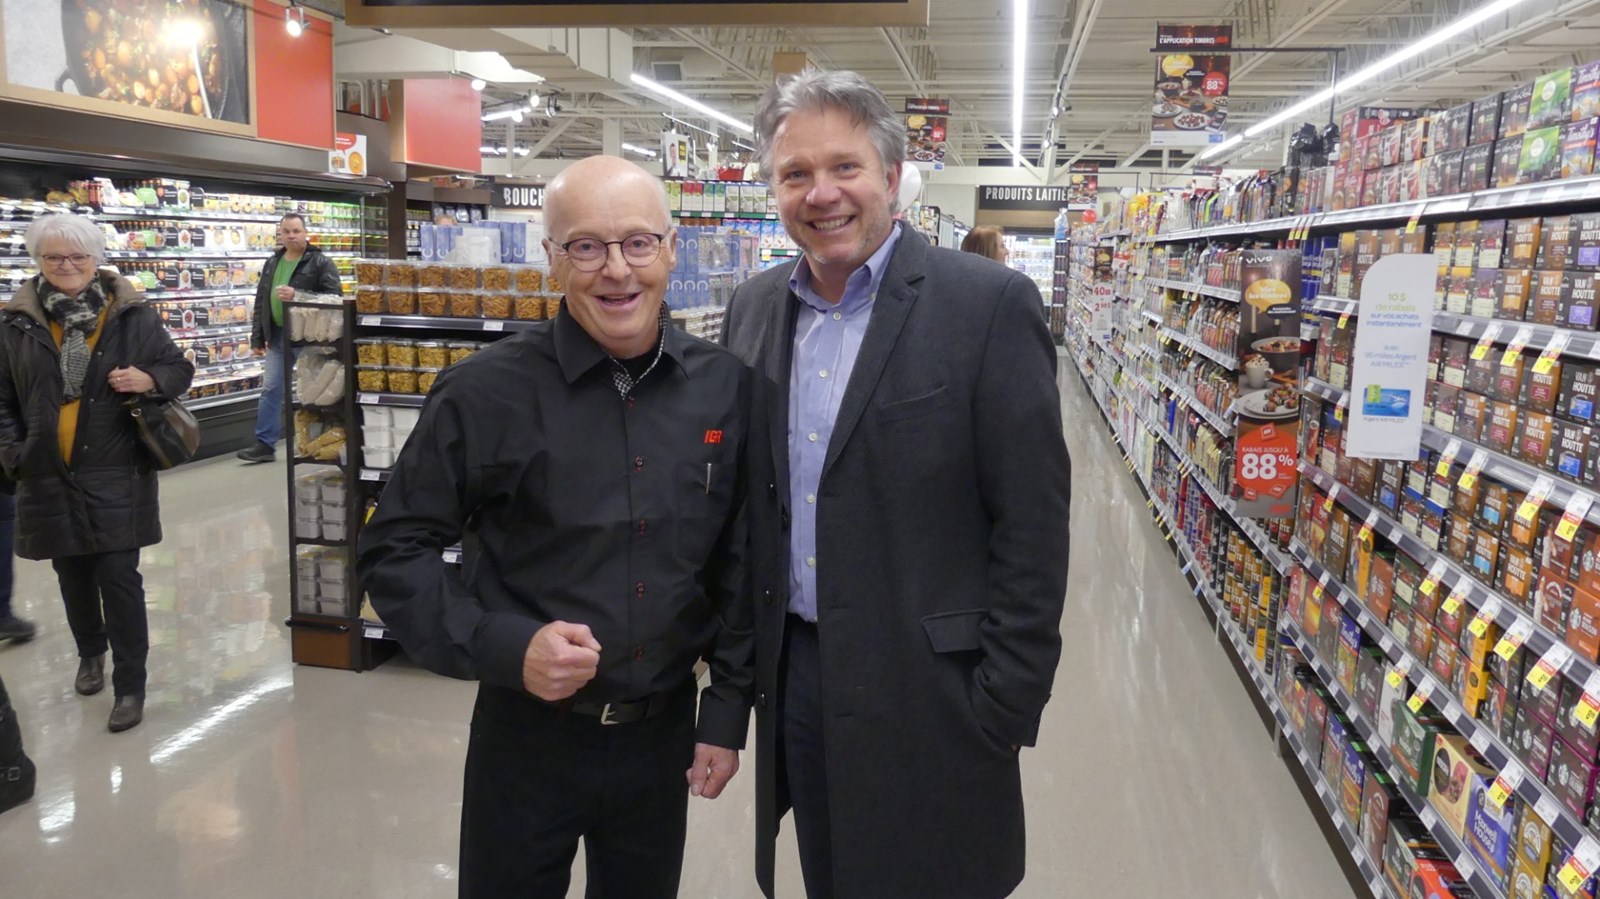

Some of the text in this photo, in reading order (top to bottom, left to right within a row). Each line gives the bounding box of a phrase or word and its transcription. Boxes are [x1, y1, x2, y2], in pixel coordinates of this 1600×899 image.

[985, 186, 1033, 201] PRODUITS
[1246, 255, 1273, 264] vivo
[1574, 278, 1587, 288] VAN
[1571, 289, 1596, 300] HOUTTE
[1575, 371, 1587, 382] VAN
[1572, 382, 1596, 395] HOUTTE
[1564, 428, 1576, 440] VAN
[1561, 438, 1583, 453] HOUTTE
[1476, 809, 1498, 841] Maxwell
[1474, 823, 1495, 854] House
